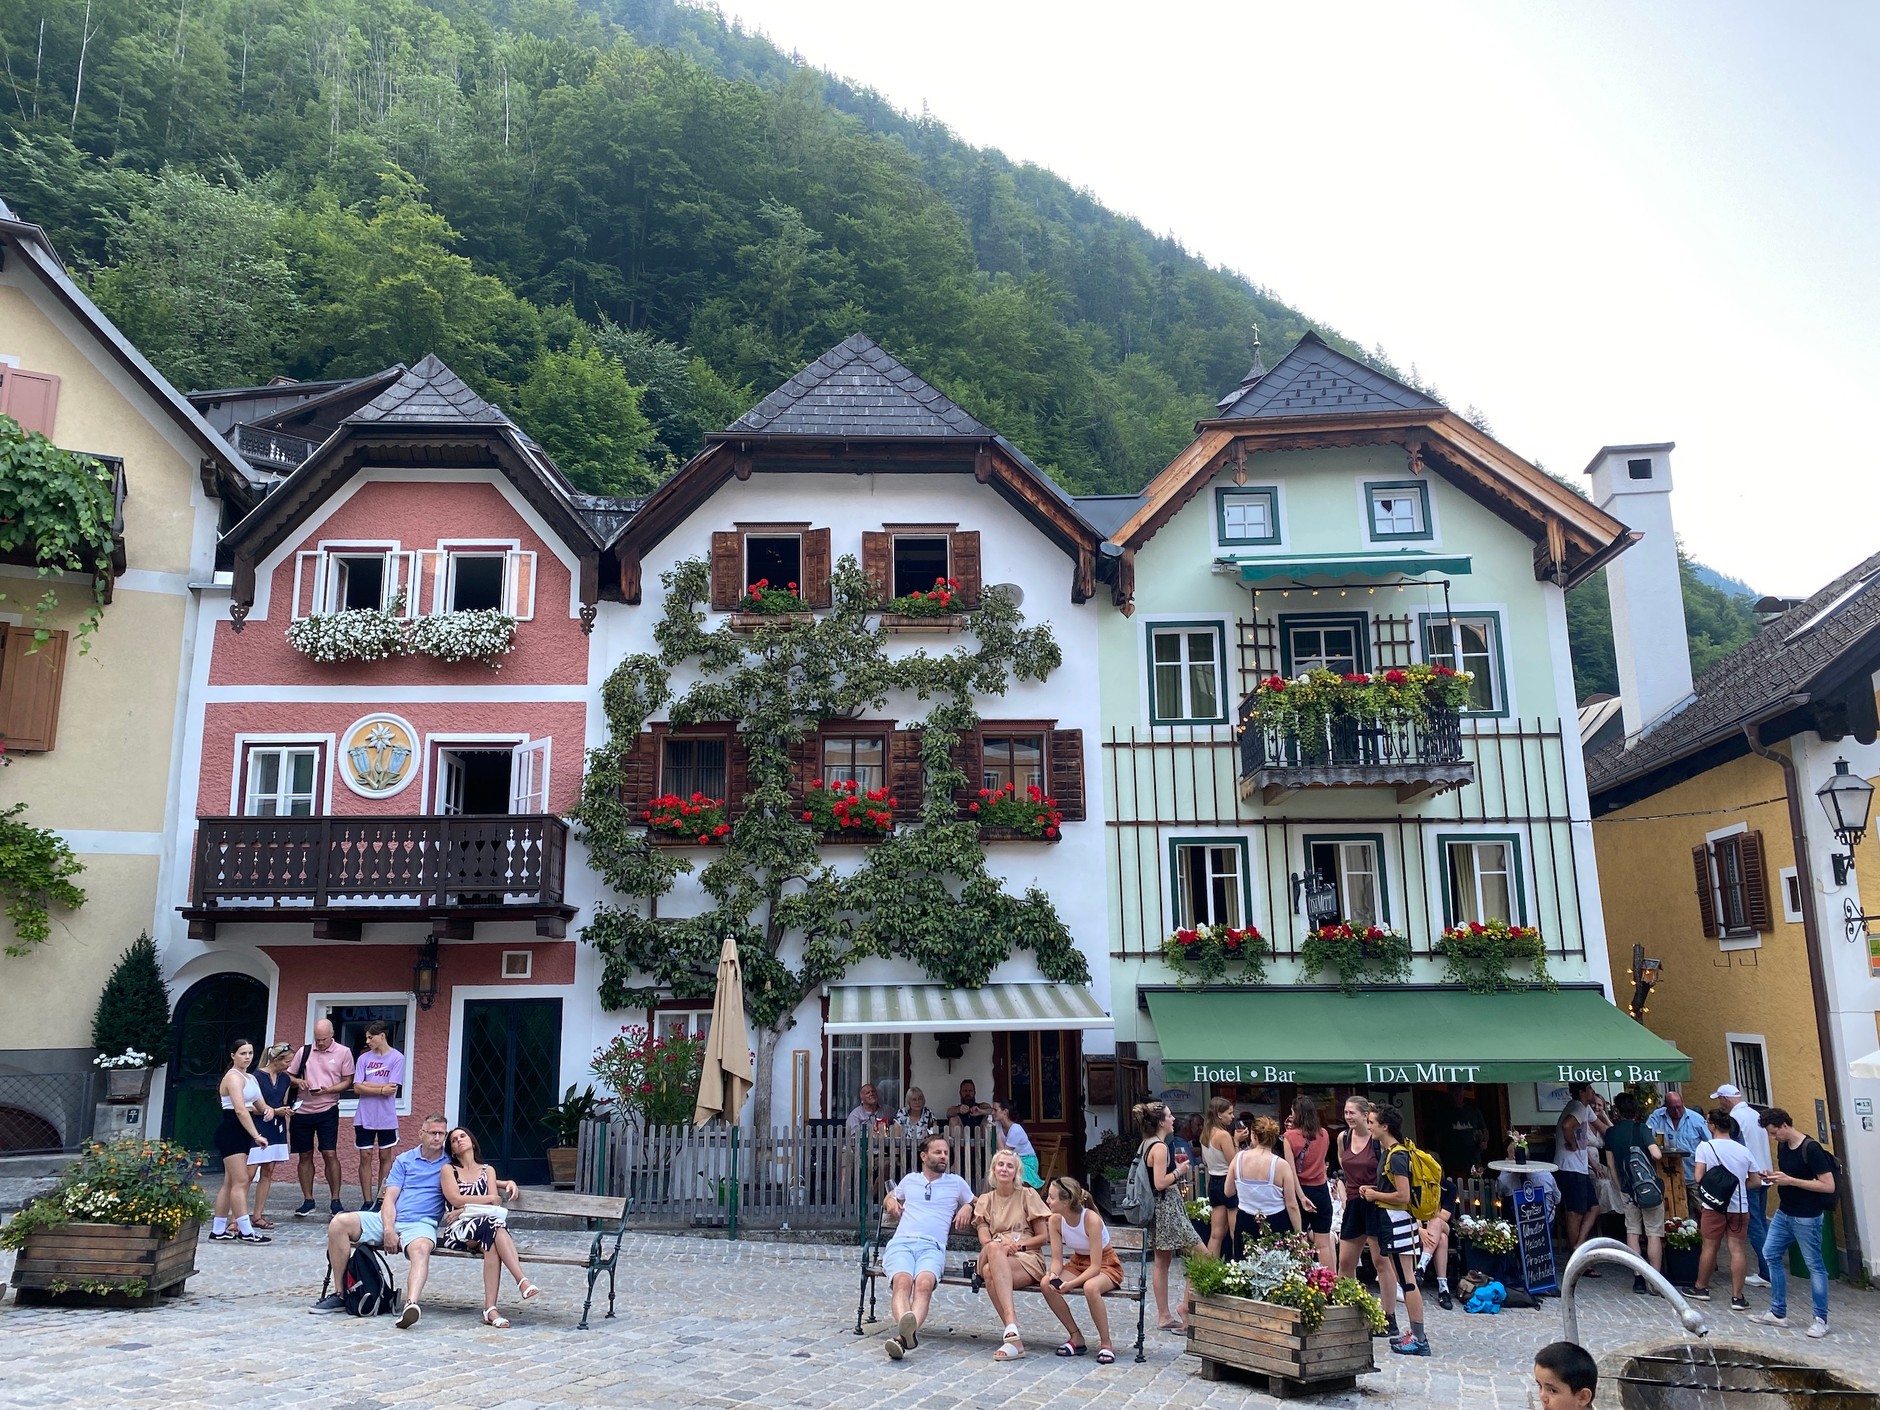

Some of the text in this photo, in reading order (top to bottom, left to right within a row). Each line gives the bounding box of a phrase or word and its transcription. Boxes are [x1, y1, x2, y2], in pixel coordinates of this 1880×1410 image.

[1193, 1065, 1296, 1082] Hotel Bar
[1364, 1063, 1481, 1083] IDA MITT
[1557, 1065, 1662, 1082] Hotel Bar
